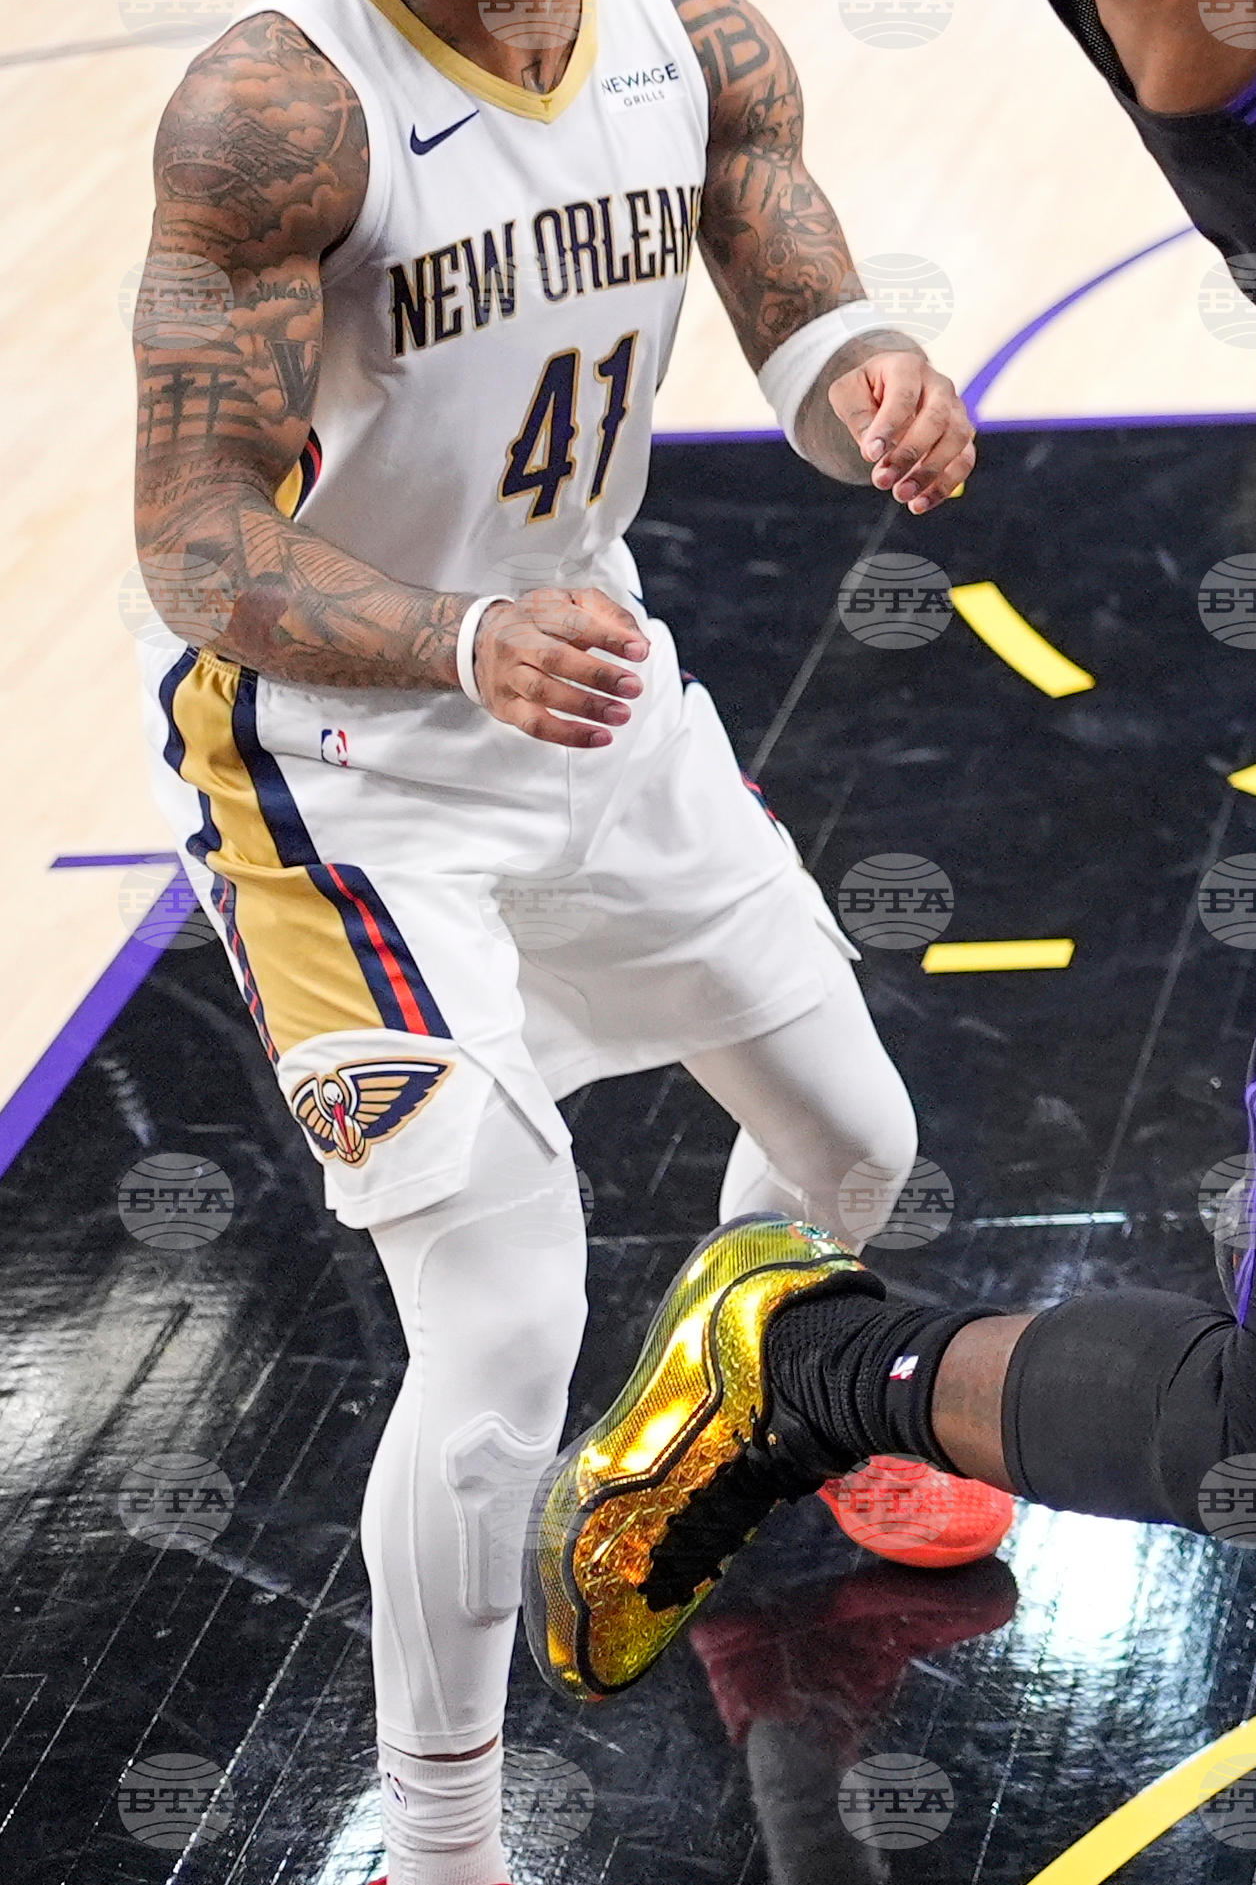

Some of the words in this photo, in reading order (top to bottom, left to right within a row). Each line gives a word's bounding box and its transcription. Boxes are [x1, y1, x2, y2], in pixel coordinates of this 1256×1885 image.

[623, 90, 666, 107] GRILLS
[389, 219, 517, 358] NEW
[532, 185, 702, 305] ORLEAN
[498, 330, 639, 525] 41
